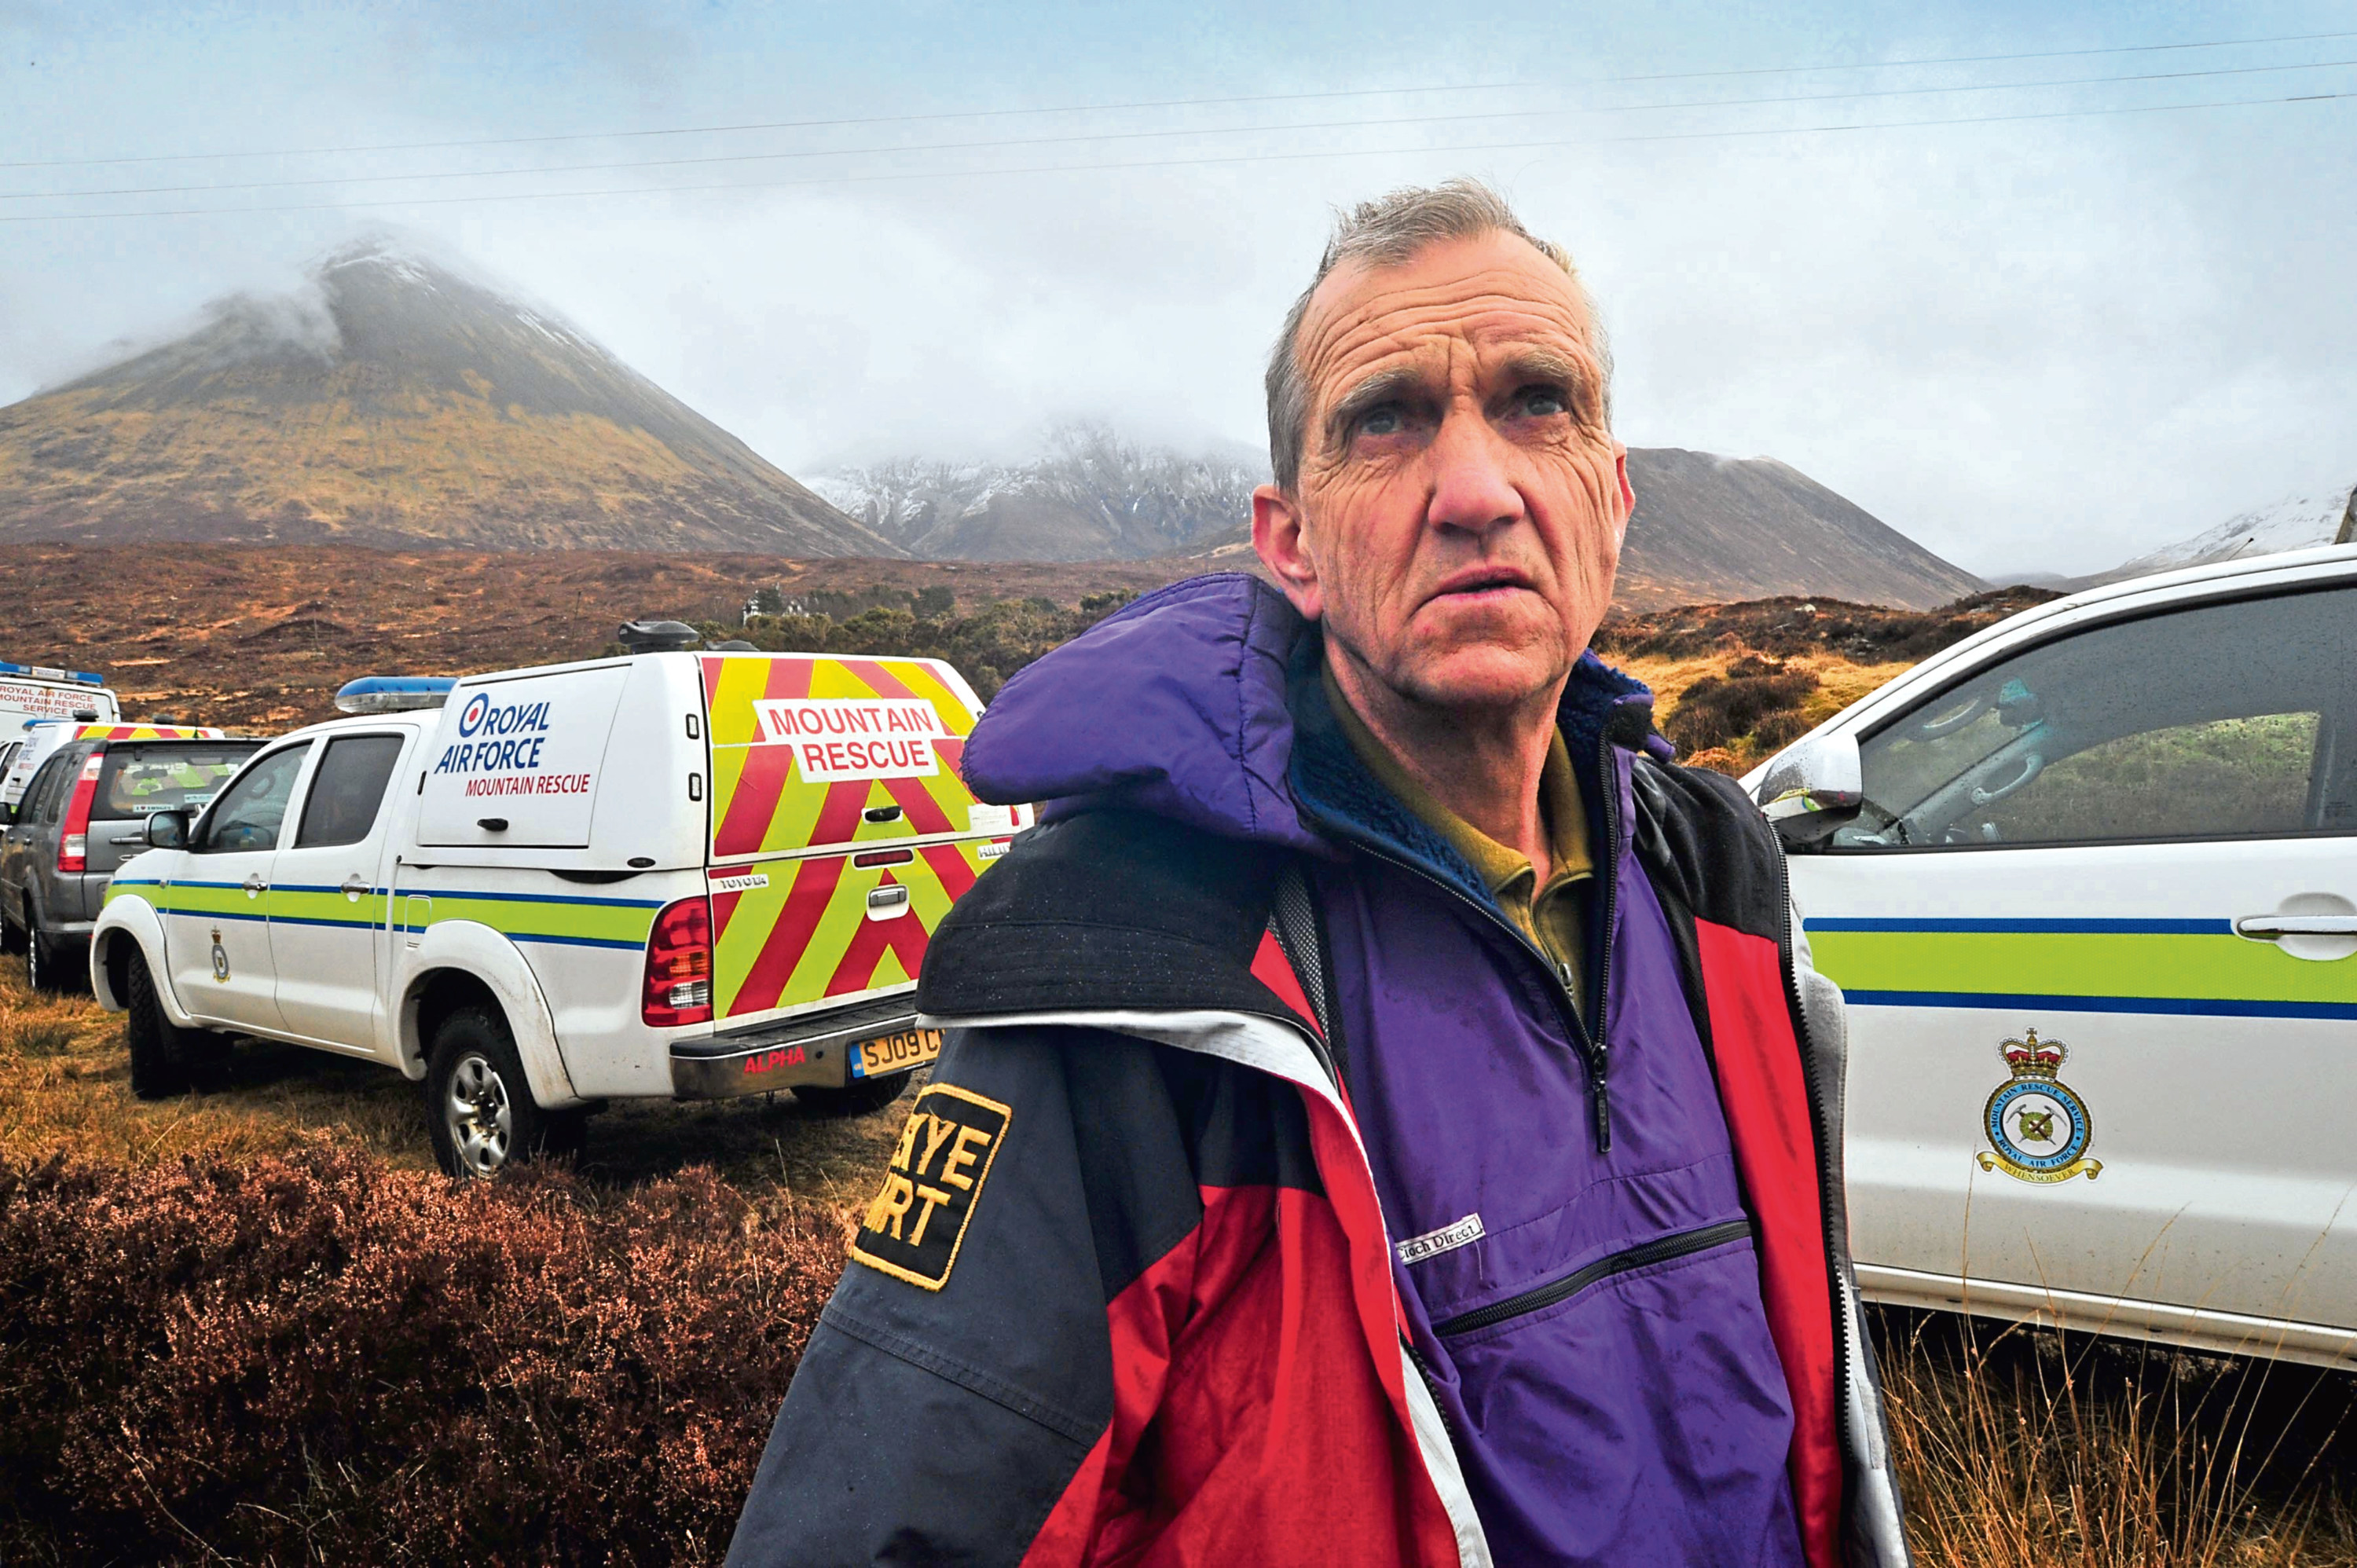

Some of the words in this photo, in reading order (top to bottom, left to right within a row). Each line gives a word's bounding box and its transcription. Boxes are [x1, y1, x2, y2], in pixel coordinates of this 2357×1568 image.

[0, 686, 34, 695] ROYAL
[58, 692, 93, 702] FORCE
[54, 699, 96, 710] RESCUE
[23, 704, 68, 715] SERVICE
[482, 702, 550, 736] ROYAL
[768, 708, 934, 735] MOUNTAIN
[434, 743, 473, 774] AIR
[472, 737, 545, 772] FORCE
[801, 740, 929, 771] RESCUE
[465, 776, 534, 797] MOUNTAIN
[536, 774, 590, 794] RESCUE
[978, 844, 1010, 858] HILU
[720, 876, 767, 888] TOYOTA
[744, 1046, 805, 1074] ALPHA
[863, 1031, 921, 1068] SJ09
[1991, 1086, 2018, 1128] MOUNTAIN
[2021, 1083, 2061, 1097] RESCUE
[2061, 1095, 2084, 1134] SERVICE
[1997, 1138, 2024, 1163] ROYAL
[2051, 1144, 2078, 1167] FORCE
[2004, 1163, 2075, 1182] WHENSOEVER
[1432, 1224, 1475, 1247] Direct
